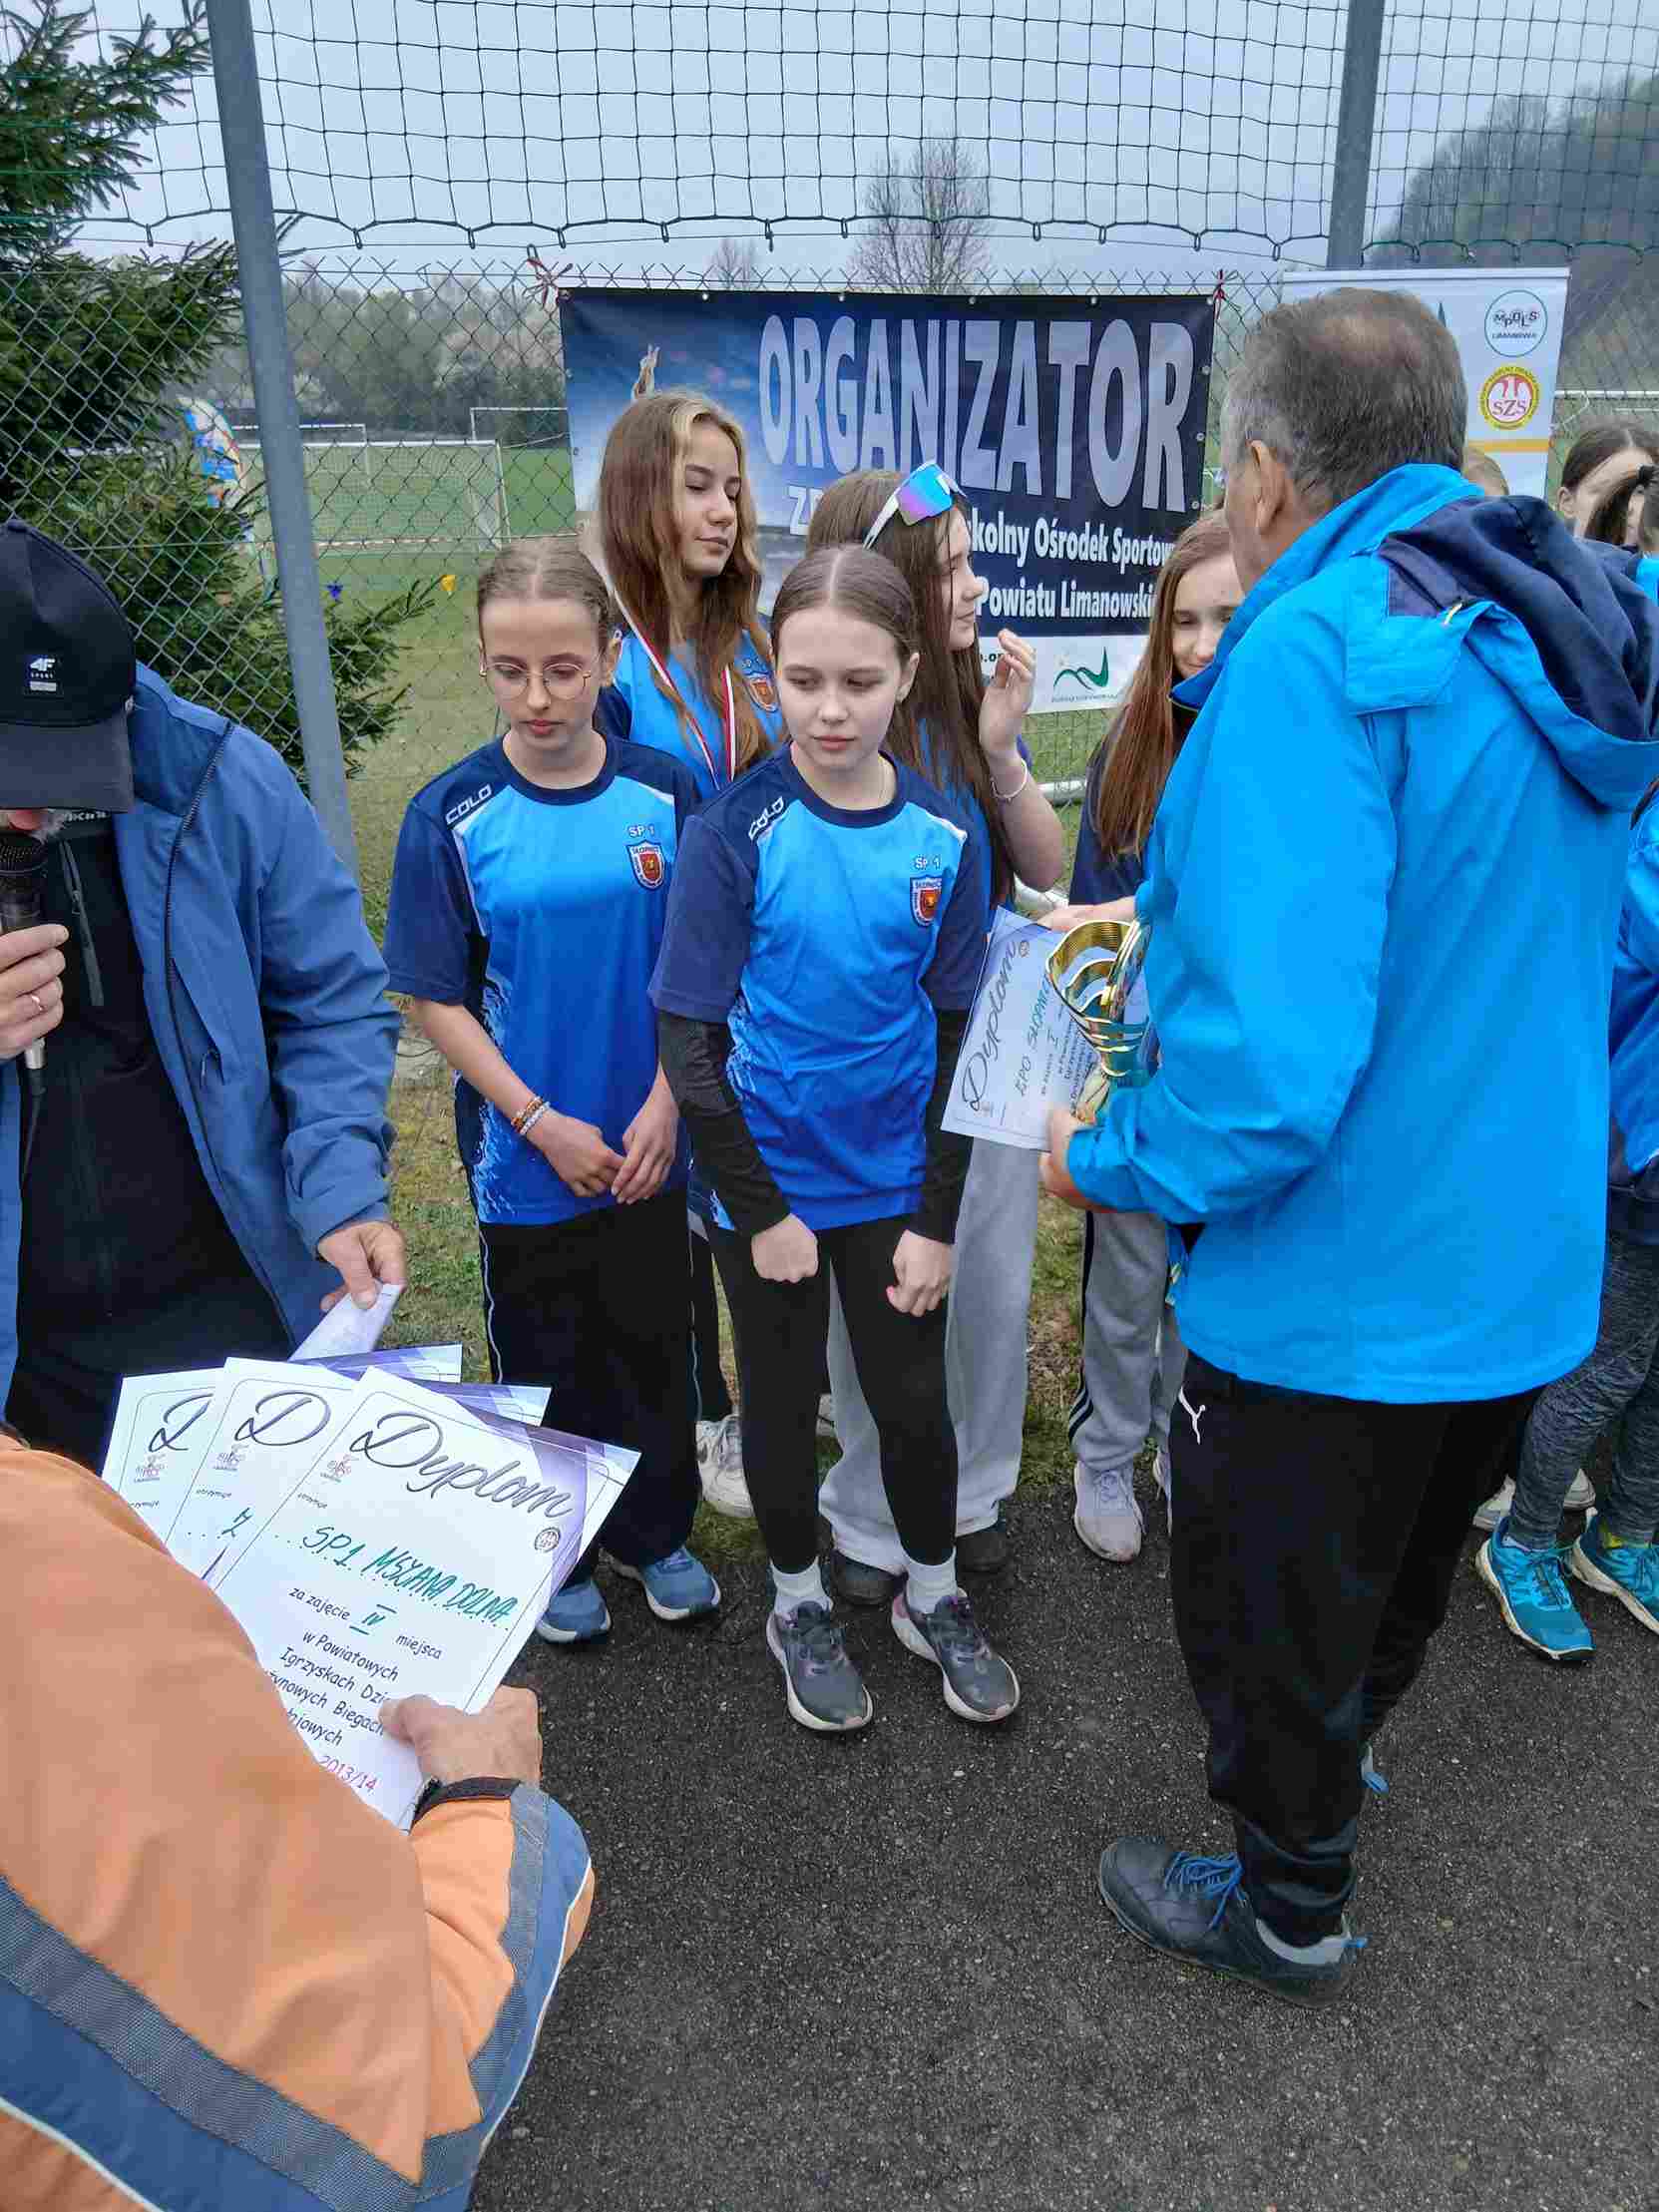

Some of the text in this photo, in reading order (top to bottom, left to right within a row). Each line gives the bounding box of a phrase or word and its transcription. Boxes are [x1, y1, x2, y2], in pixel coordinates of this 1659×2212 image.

[759, 314, 1194, 513] ORGANIZATOR
[1492, 399, 1527, 417] SZS
[967, 506, 1030, 568] kolny
[1035, 517, 1109, 563] Ośrodek
[975, 576, 1055, 619] Powiatu
[30, 659, 56, 671] 4F
[446, 783, 492, 824] COLO
[749, 795, 784, 840] COLO
[628, 824, 645, 838] SP
[915, 855, 928, 870] SP
[962, 939, 1017, 1112] Dyplom
[349, 1412, 574, 1519] Dyplom
[288, 1586, 351, 1621] za zajęcie
[443, 1582, 519, 1623] DOLNA
[302, 1630, 399, 1682] w Powiatowych
[396, 1633, 442, 1660] miejsca
[280, 1646, 355, 1692] Igrzyskach
